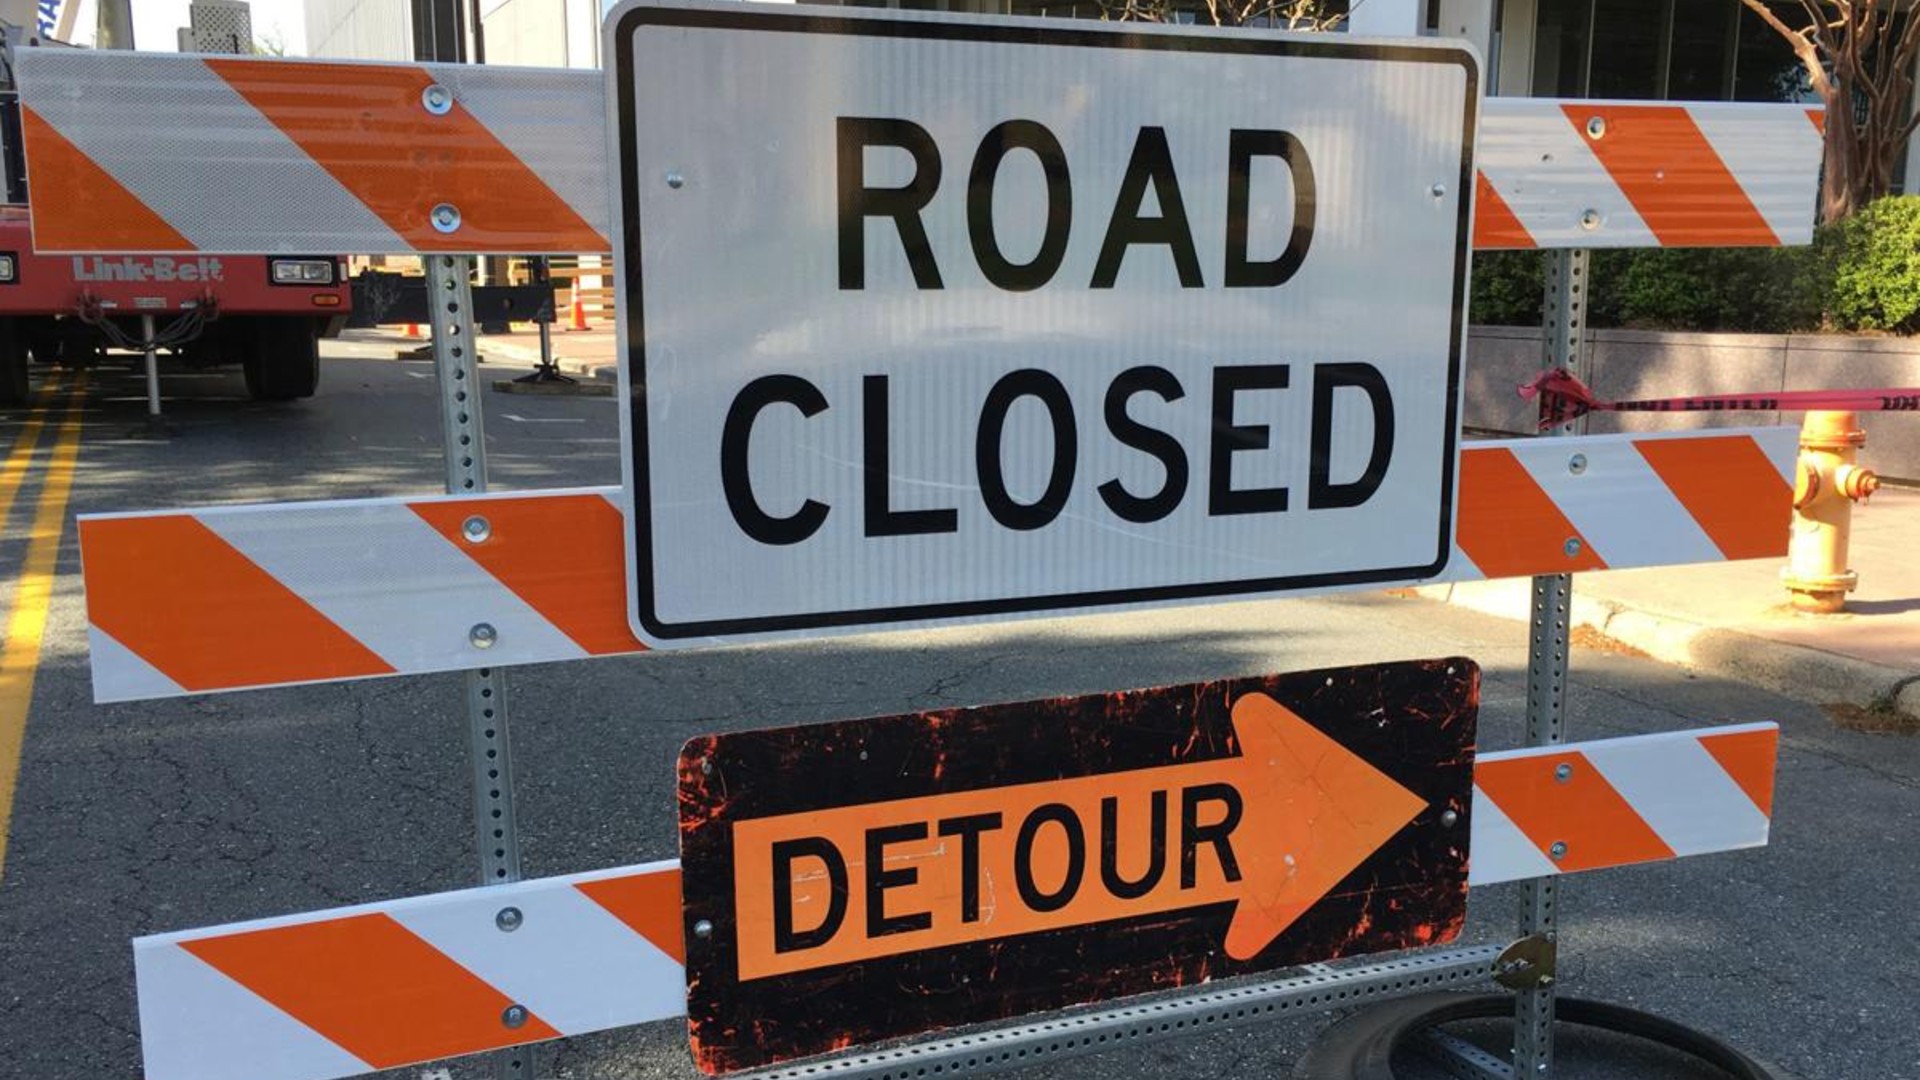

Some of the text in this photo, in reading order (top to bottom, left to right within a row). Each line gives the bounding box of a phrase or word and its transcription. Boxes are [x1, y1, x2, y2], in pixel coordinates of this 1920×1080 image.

[73, 256, 222, 282] Link-Belt
[837, 117, 1315, 291] ROAD
[721, 362, 1395, 545] CLOSED
[772, 783, 1243, 954] DETOUR
